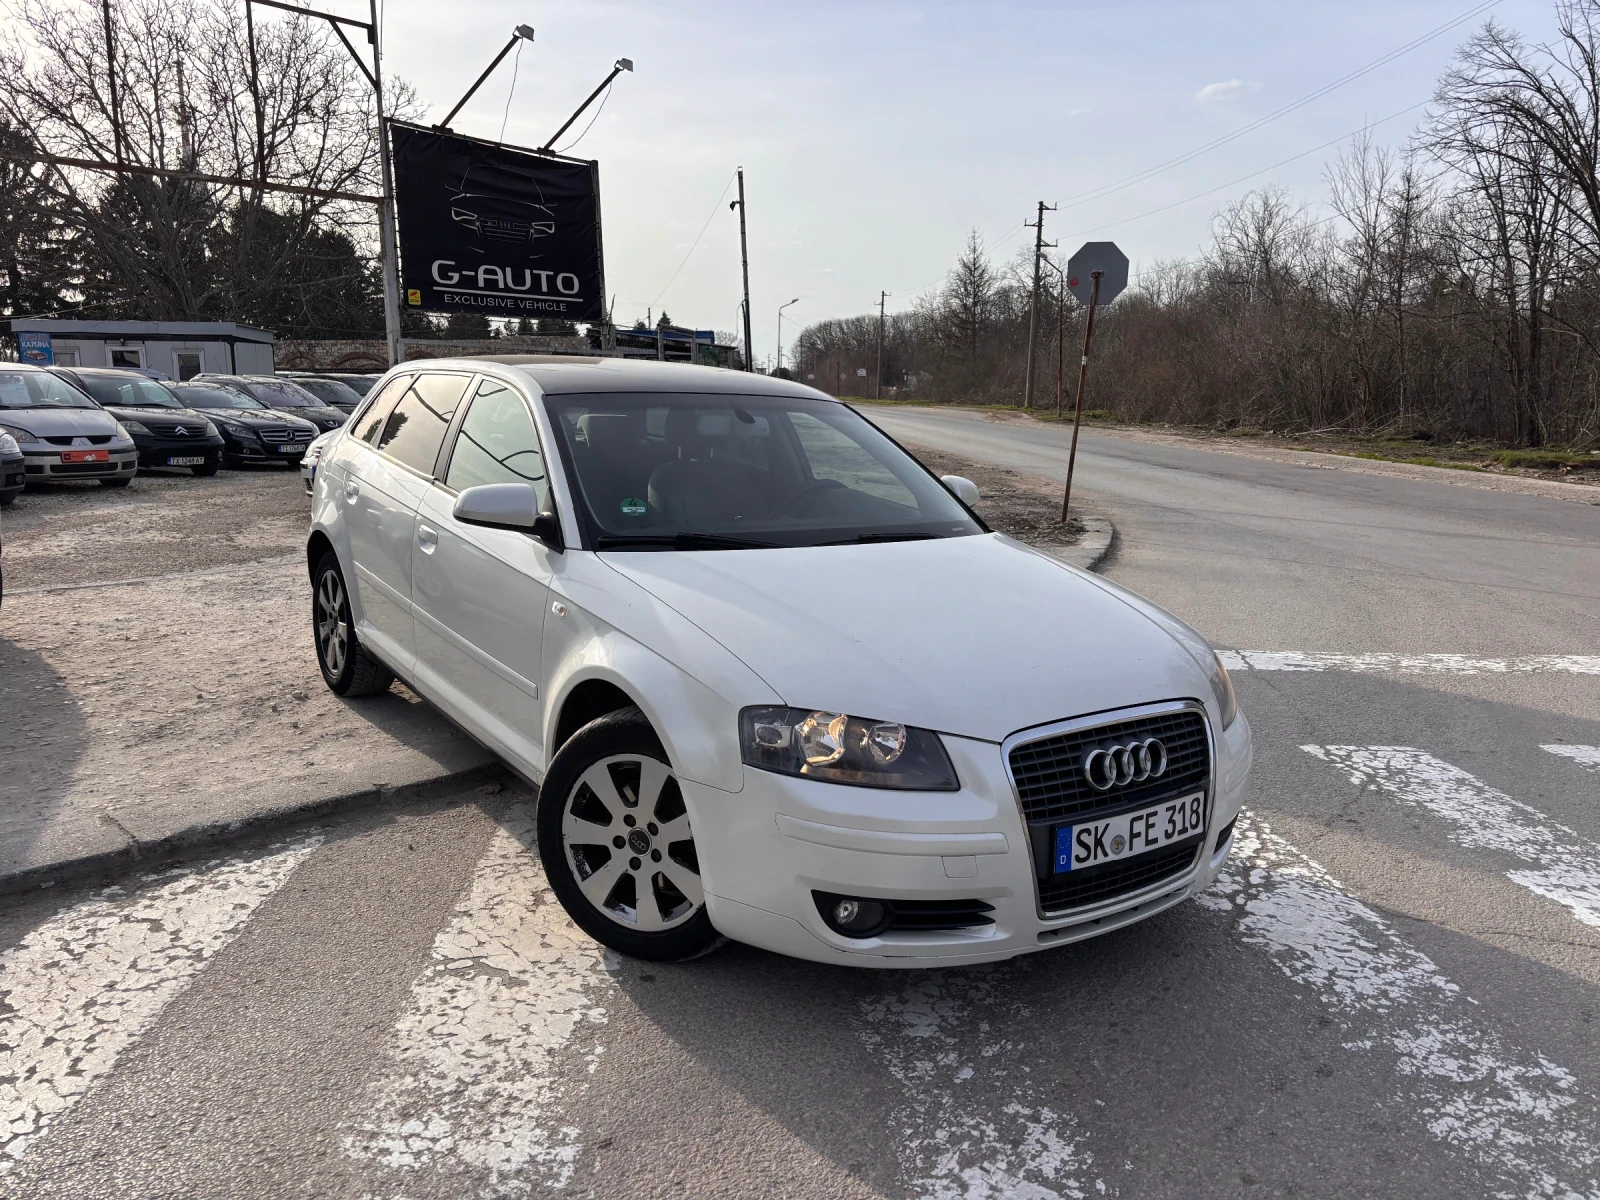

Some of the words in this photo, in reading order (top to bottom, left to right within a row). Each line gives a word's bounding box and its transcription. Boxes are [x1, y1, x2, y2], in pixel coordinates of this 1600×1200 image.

[431, 259, 580, 295] G-AUTO
[444, 294, 515, 308] EXCLUSIVE
[518, 300, 568, 312] VEHICLE
[1074, 823, 1110, 863] SK
[1129, 810, 1159, 852] FE
[1164, 797, 1201, 840] 318
